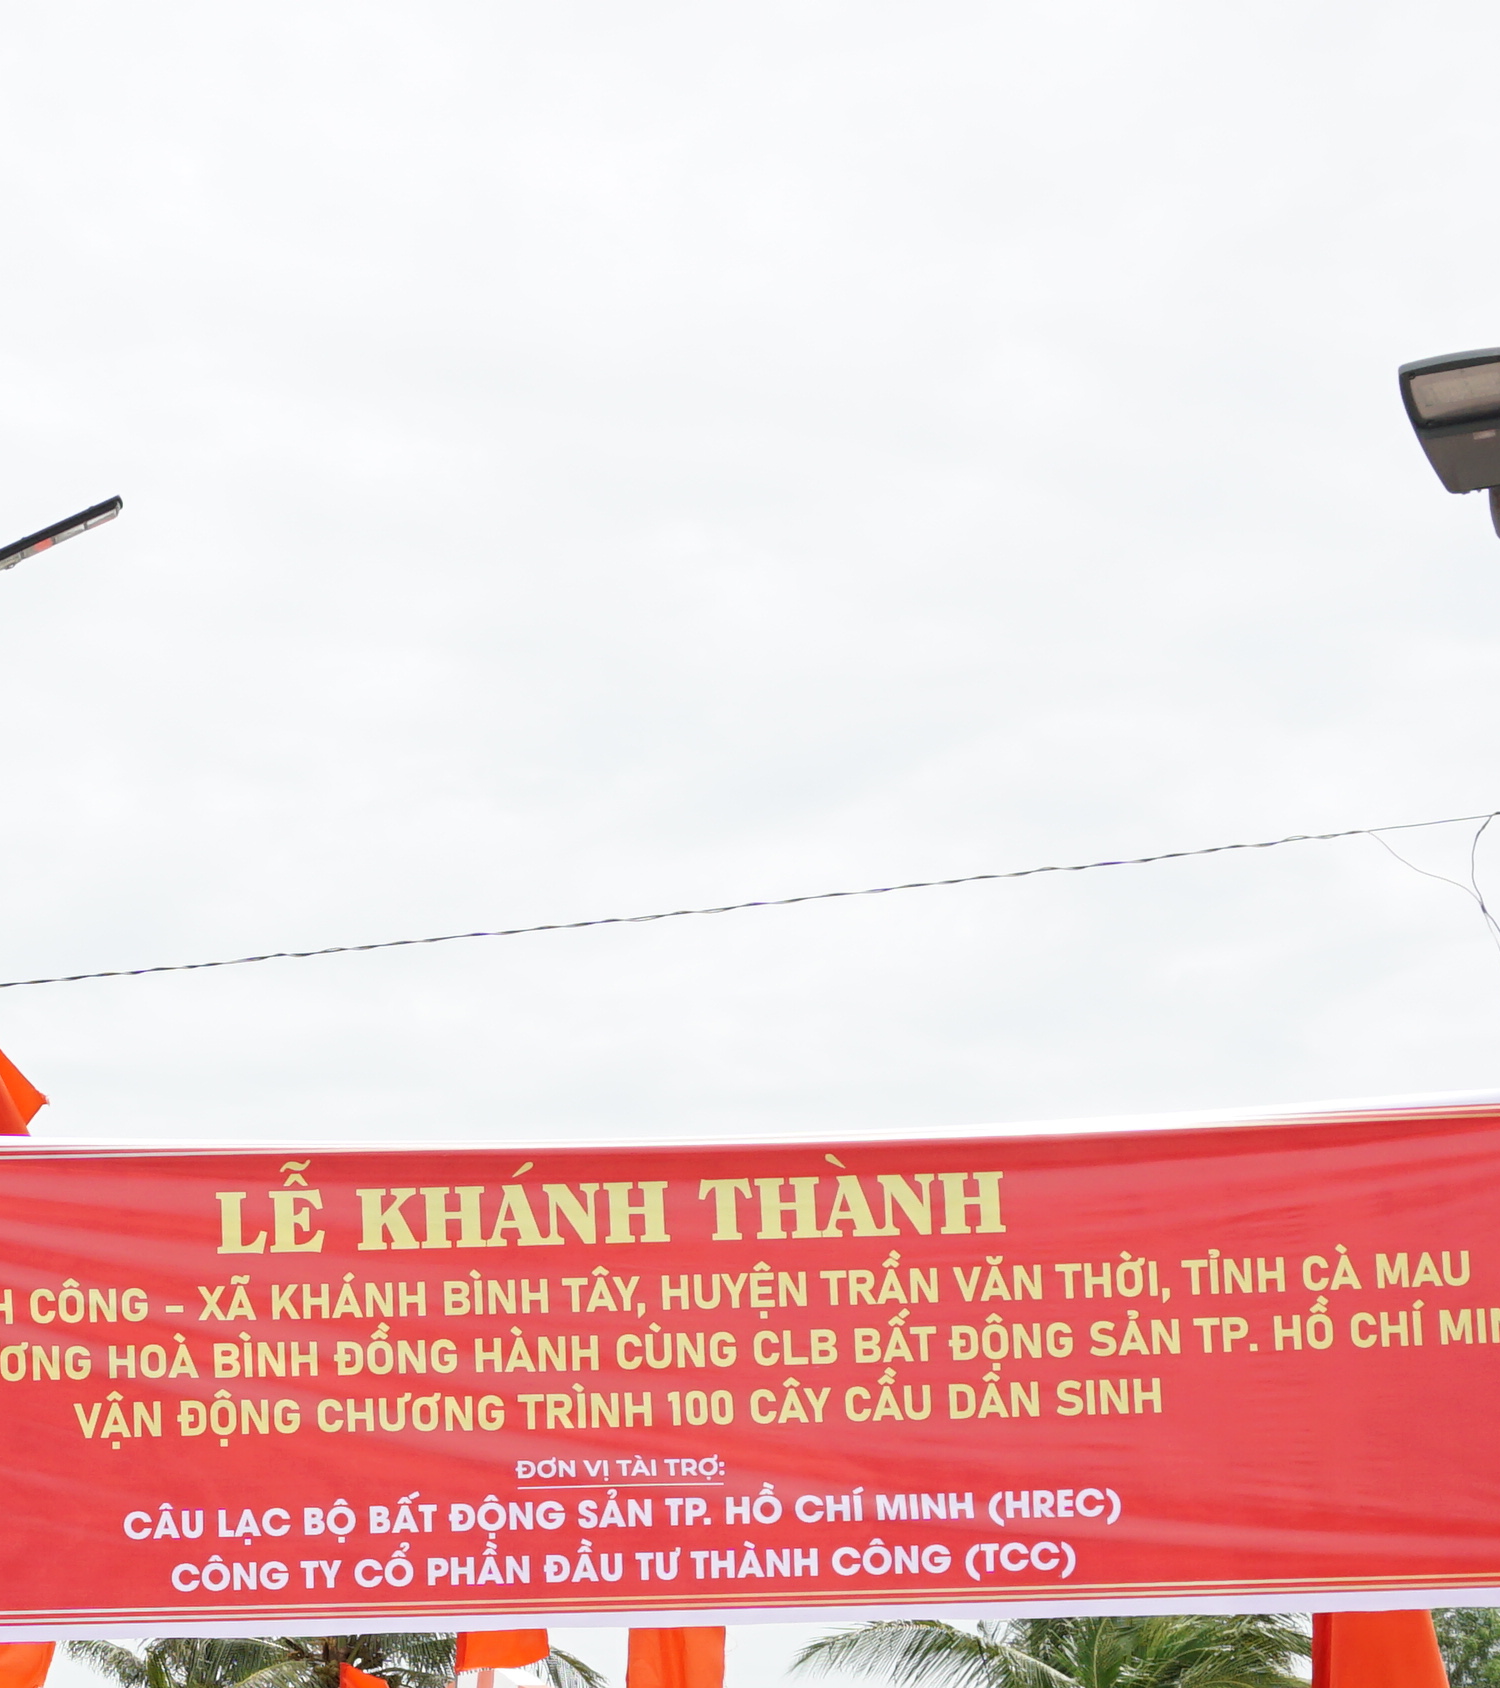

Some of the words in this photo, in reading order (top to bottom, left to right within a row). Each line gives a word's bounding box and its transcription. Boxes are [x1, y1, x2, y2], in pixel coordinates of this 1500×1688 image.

[215, 1159, 326, 1255] LỄ
[355, 1161, 671, 1251] KHÁNH
[698, 1153, 1007, 1241] THÀNH
[29, 1277, 149, 1324] CÔNG
[197, 1274, 257, 1322] XÃ
[271, 1271, 427, 1321] KHÁNH
[443, 1269, 550, 1316] BÌNH
[561, 1265, 646, 1319] TÂY,
[660, 1260, 808, 1320] HUYỆN
[819, 1249, 939, 1306] TRẦN
[952, 1255, 1043, 1302] VĂN
[1054, 1250, 1171, 1304] THỜI,
[1180, 1248, 1286, 1296] TỈNH
[1302, 1243, 1363, 1292] CÀ
[1375, 1250, 1471, 1289] MAU
[108, 1332, 200, 1379] HOÀ
[213, 1331, 319, 1379] BÌNH
[333, 1321, 458, 1376] ĐỒNG
[474, 1325, 600, 1373] HÀNH
[616, 1321, 738, 1370] CÙNG
[752, 1328, 839, 1367] CLB
[853, 1307, 937, 1364] BẤT
[947, 1312, 1074, 1372] ĐỘNG
[1089, 1309, 1181, 1357] SẢN
[1192, 1316, 1259, 1354] TP.
[1273, 1295, 1334, 1351] HỒ
[1350, 1299, 1425, 1349] CHÍ
[73, 1390, 162, 1450] VẬN
[176, 1388, 301, 1448] ĐỘNG
[316, 1392, 505, 1433] CHƯƠNG
[517, 1382, 653, 1430] TRÌNH
[666, 1389, 735, 1427] 100
[749, 1376, 832, 1425] CÂY
[844, 1366, 932, 1422] CẦU
[1056, 1377, 1163, 1417] SINH
[514, 1456, 577, 1479] ĐƠN
[582, 1459, 610, 1482] VỊ
[615, 1454, 658, 1477] TÀI
[663, 1453, 726, 1481] TRỢ:
[123, 1502, 204, 1540] CÂU
[217, 1507, 291, 1546] LẠC
[303, 1498, 357, 1544] BỘ
[368, 1490, 438, 1534] BẤT
[448, 1494, 566, 1541] ĐỘNG
[577, 1488, 653, 1529] SẢN
[664, 1497, 712, 1527] TP.
[725, 1481, 783, 1525] HỒ
[794, 1486, 865, 1524] CHÍ
[875, 1491, 975, 1521] MINH
[987, 1487, 1122, 1527] (HREC)
[171, 1554, 290, 1593] CÔNG
[299, 1559, 342, 1589] TY
[354, 1541, 414, 1588] CỔ
[427, 1539, 531, 1586] PHẦN
[543, 1538, 624, 1583] ĐẦU
[634, 1546, 682, 1581] TƯ
[689, 1540, 819, 1580] THÀNH
[831, 1537, 952, 1577] CÔNG
[964, 1541, 1077, 1582] (TCC)
